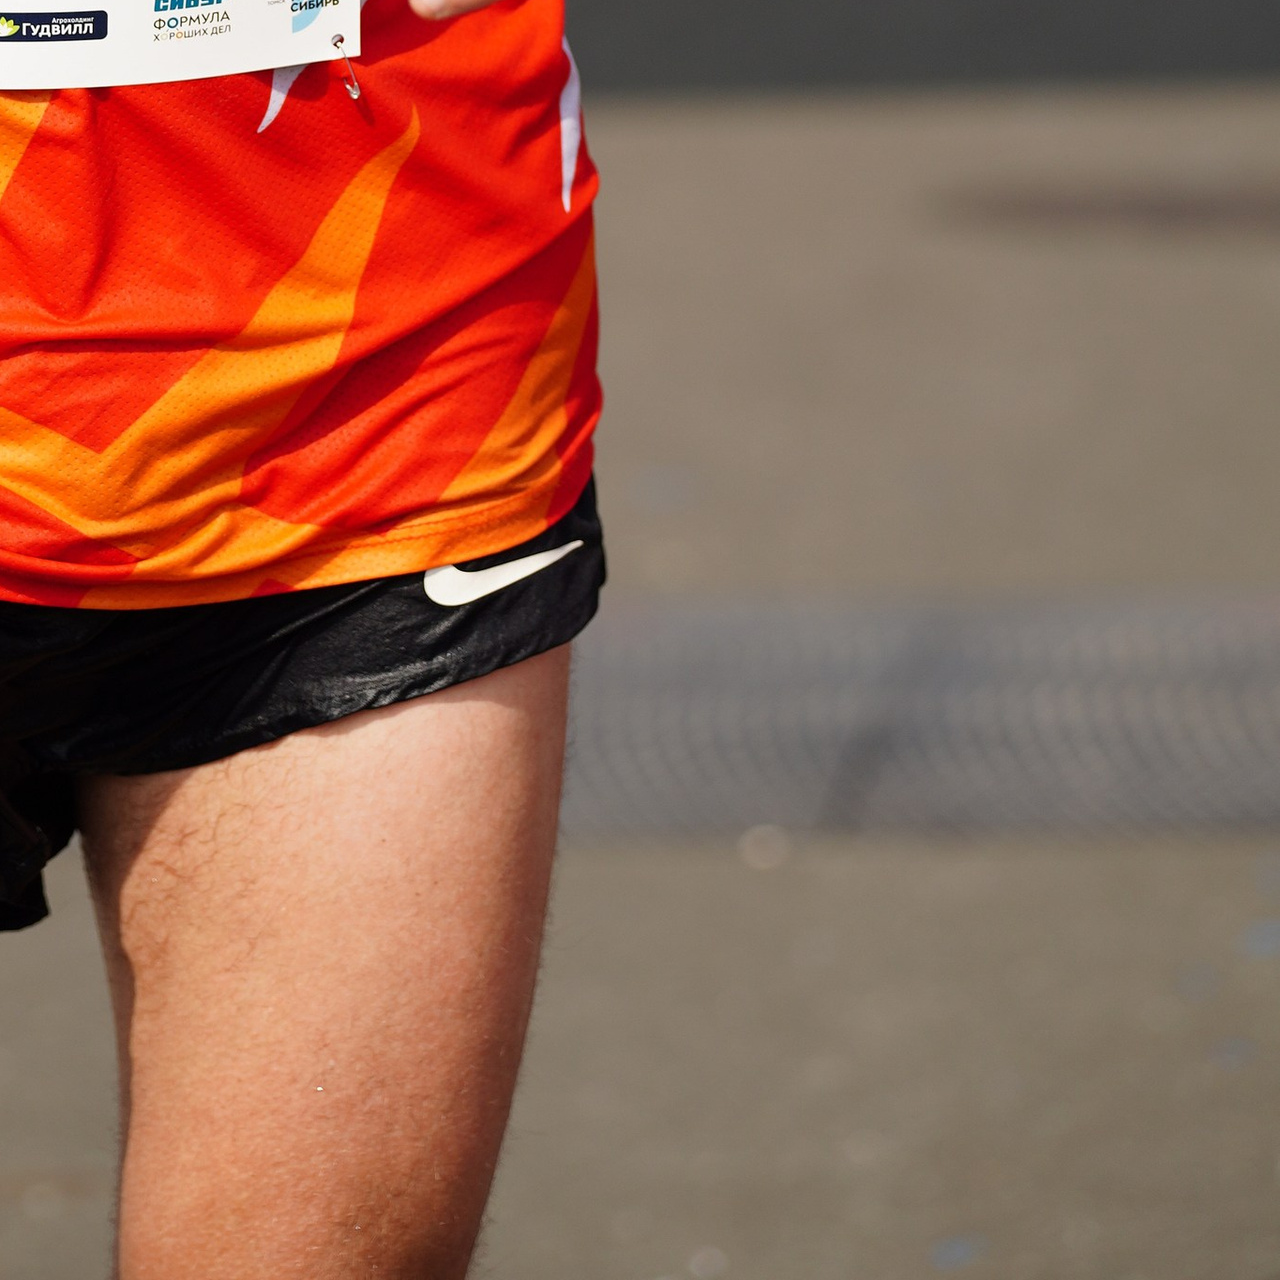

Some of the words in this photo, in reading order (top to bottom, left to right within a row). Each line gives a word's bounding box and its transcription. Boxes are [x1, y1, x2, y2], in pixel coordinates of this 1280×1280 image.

[153, 10, 231, 30] ФОРМУЛА
[22, 22, 94, 38] Гудвилл
[153, 27, 208, 42] ХОРОШИХ
[210, 24, 231, 36] ДЕЛ
